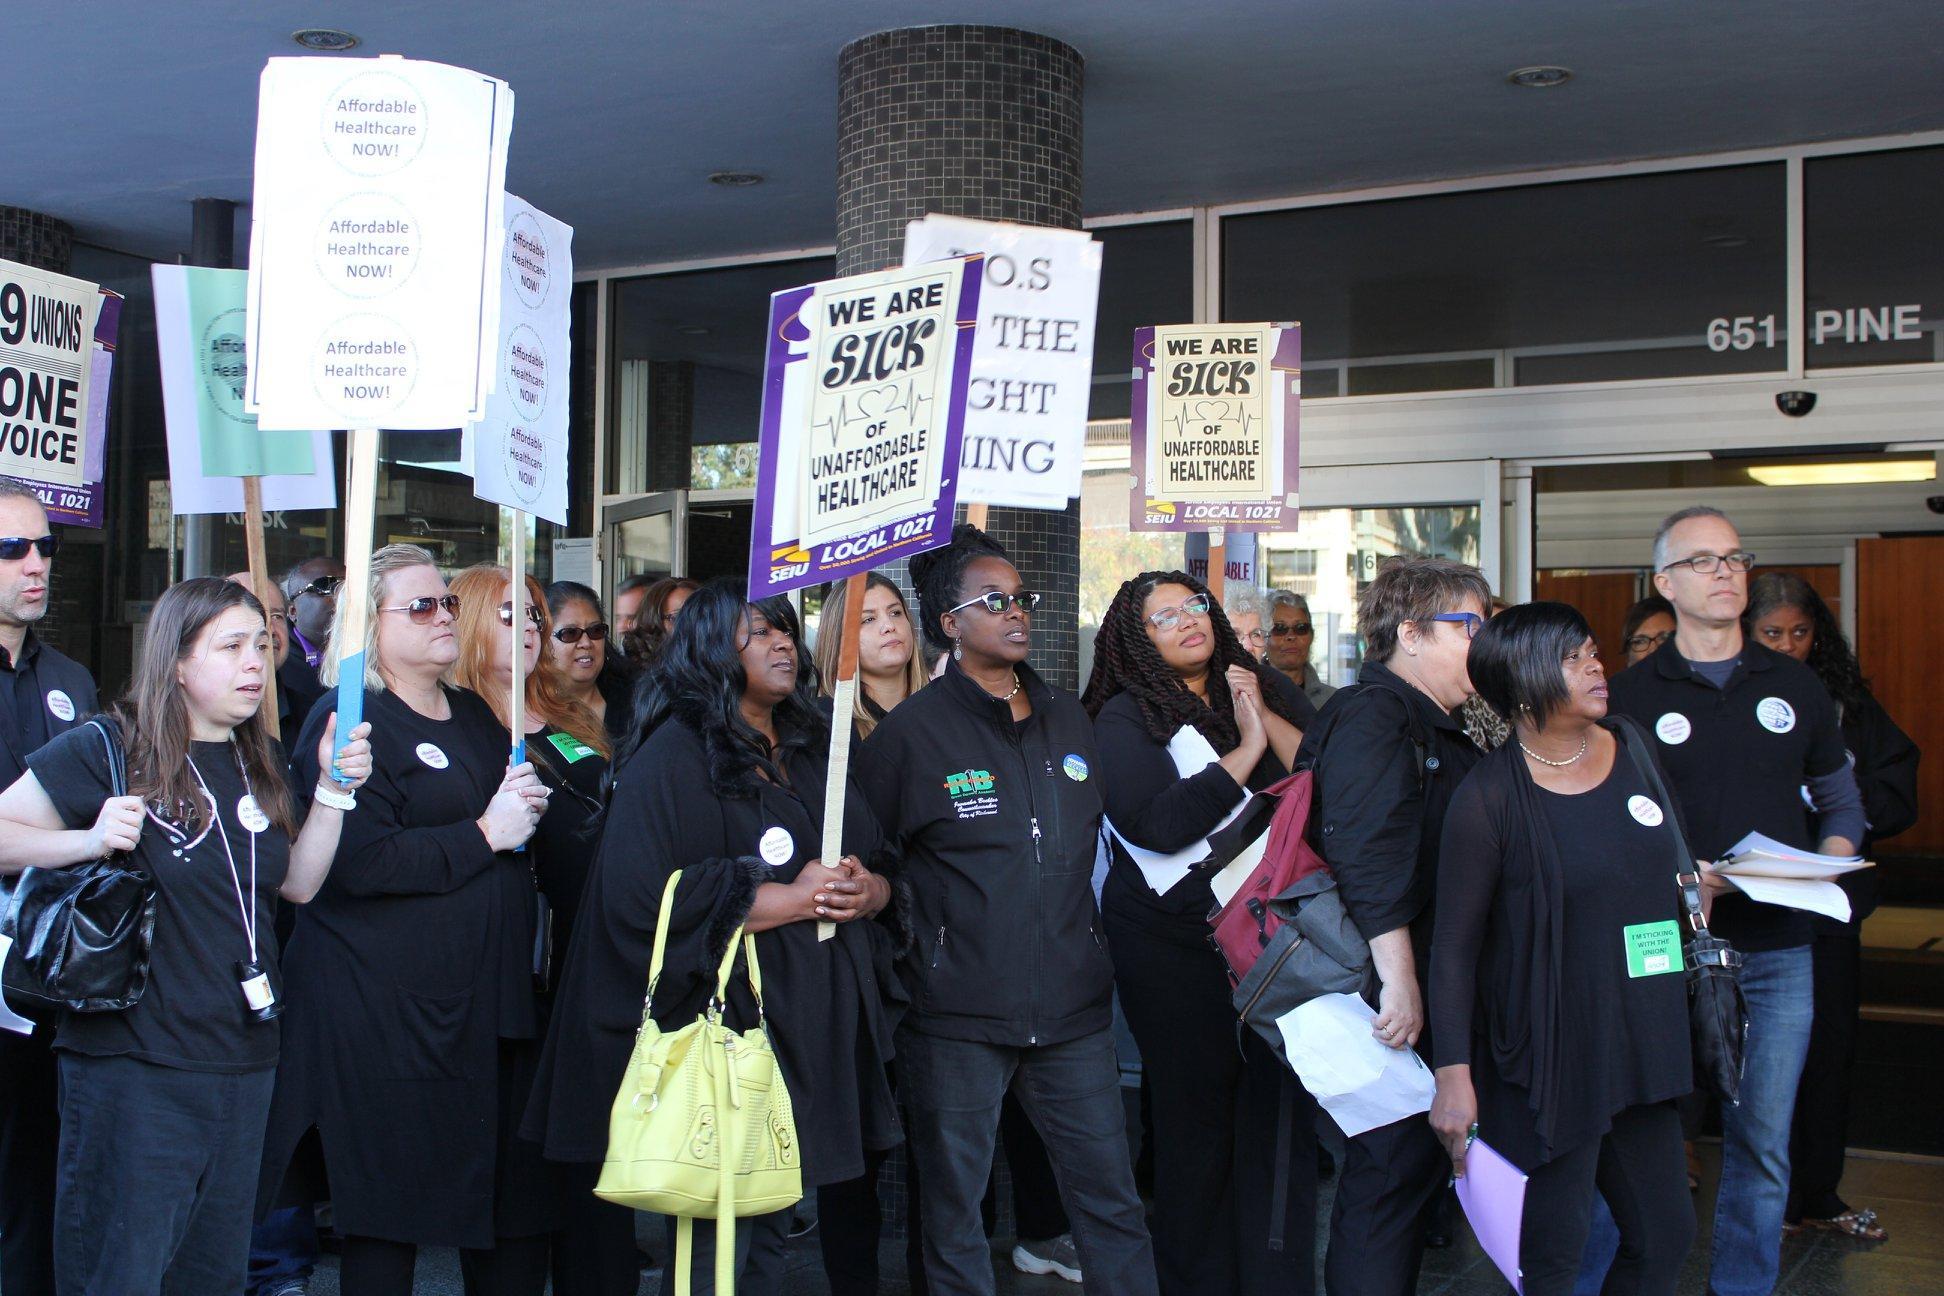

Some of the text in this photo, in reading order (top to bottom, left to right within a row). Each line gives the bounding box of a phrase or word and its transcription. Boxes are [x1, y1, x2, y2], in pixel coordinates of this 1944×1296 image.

[337, 99, 417, 113] Affordable
[334, 121, 416, 135] Healthcare
[352, 143, 399, 157] NOW!
[329, 219, 409, 234] Affordable
[327, 242, 410, 256] Healthcare
[512, 232, 545, 259] Affordable
[346, 264, 392, 278] NOW!
[511, 251, 547, 278] Healthcare
[520, 274, 540, 294] NOW!
[829, 282, 944, 327] WE ARE
[0, 283, 82, 353] 9 UNIONS
[1707, 304, 1922, 352] 651 PINE
[992, 313, 1079, 352] THE
[326, 340, 406, 355] Affordable
[512, 345, 544, 369] Affordable
[823, 318, 936, 389] SICK
[1167, 338, 1258, 356] WE ARE
[325, 363, 407, 377] Healthcare
[510, 364, 544, 389] Healthcare
[1167, 360, 1256, 397] SICK
[0, 367, 79, 429] ONE
[344, 385, 390, 399] NOW!
[519, 388, 539, 406] NOW!
[968, 376, 1056, 415] GHT
[510, 427, 542, 452] Affordable
[866, 421, 887, 439] OF
[1203, 425, 1222, 435] OF
[812, 429, 927, 480] UNAFFORDABLE
[1164, 440, 1260, 457] UNAFFORDABLE
[509, 447, 542, 471] Healthcare
[518, 470, 537, 488] NOW!
[1170, 460, 1256, 482] HEALTHCARE
[818, 459, 918, 515] HEALTHCARE
[60, 493, 91, 510] 1021
[1144, 514, 1176, 524] SEIU
[1184, 505, 1282, 519] LOCAL 1021
[821, 532, 887, 563] LOCAL
[893, 514, 935, 541] 1021
[768, 562, 811, 584] SEIU
[1637, 940, 1656, 948] WITH
